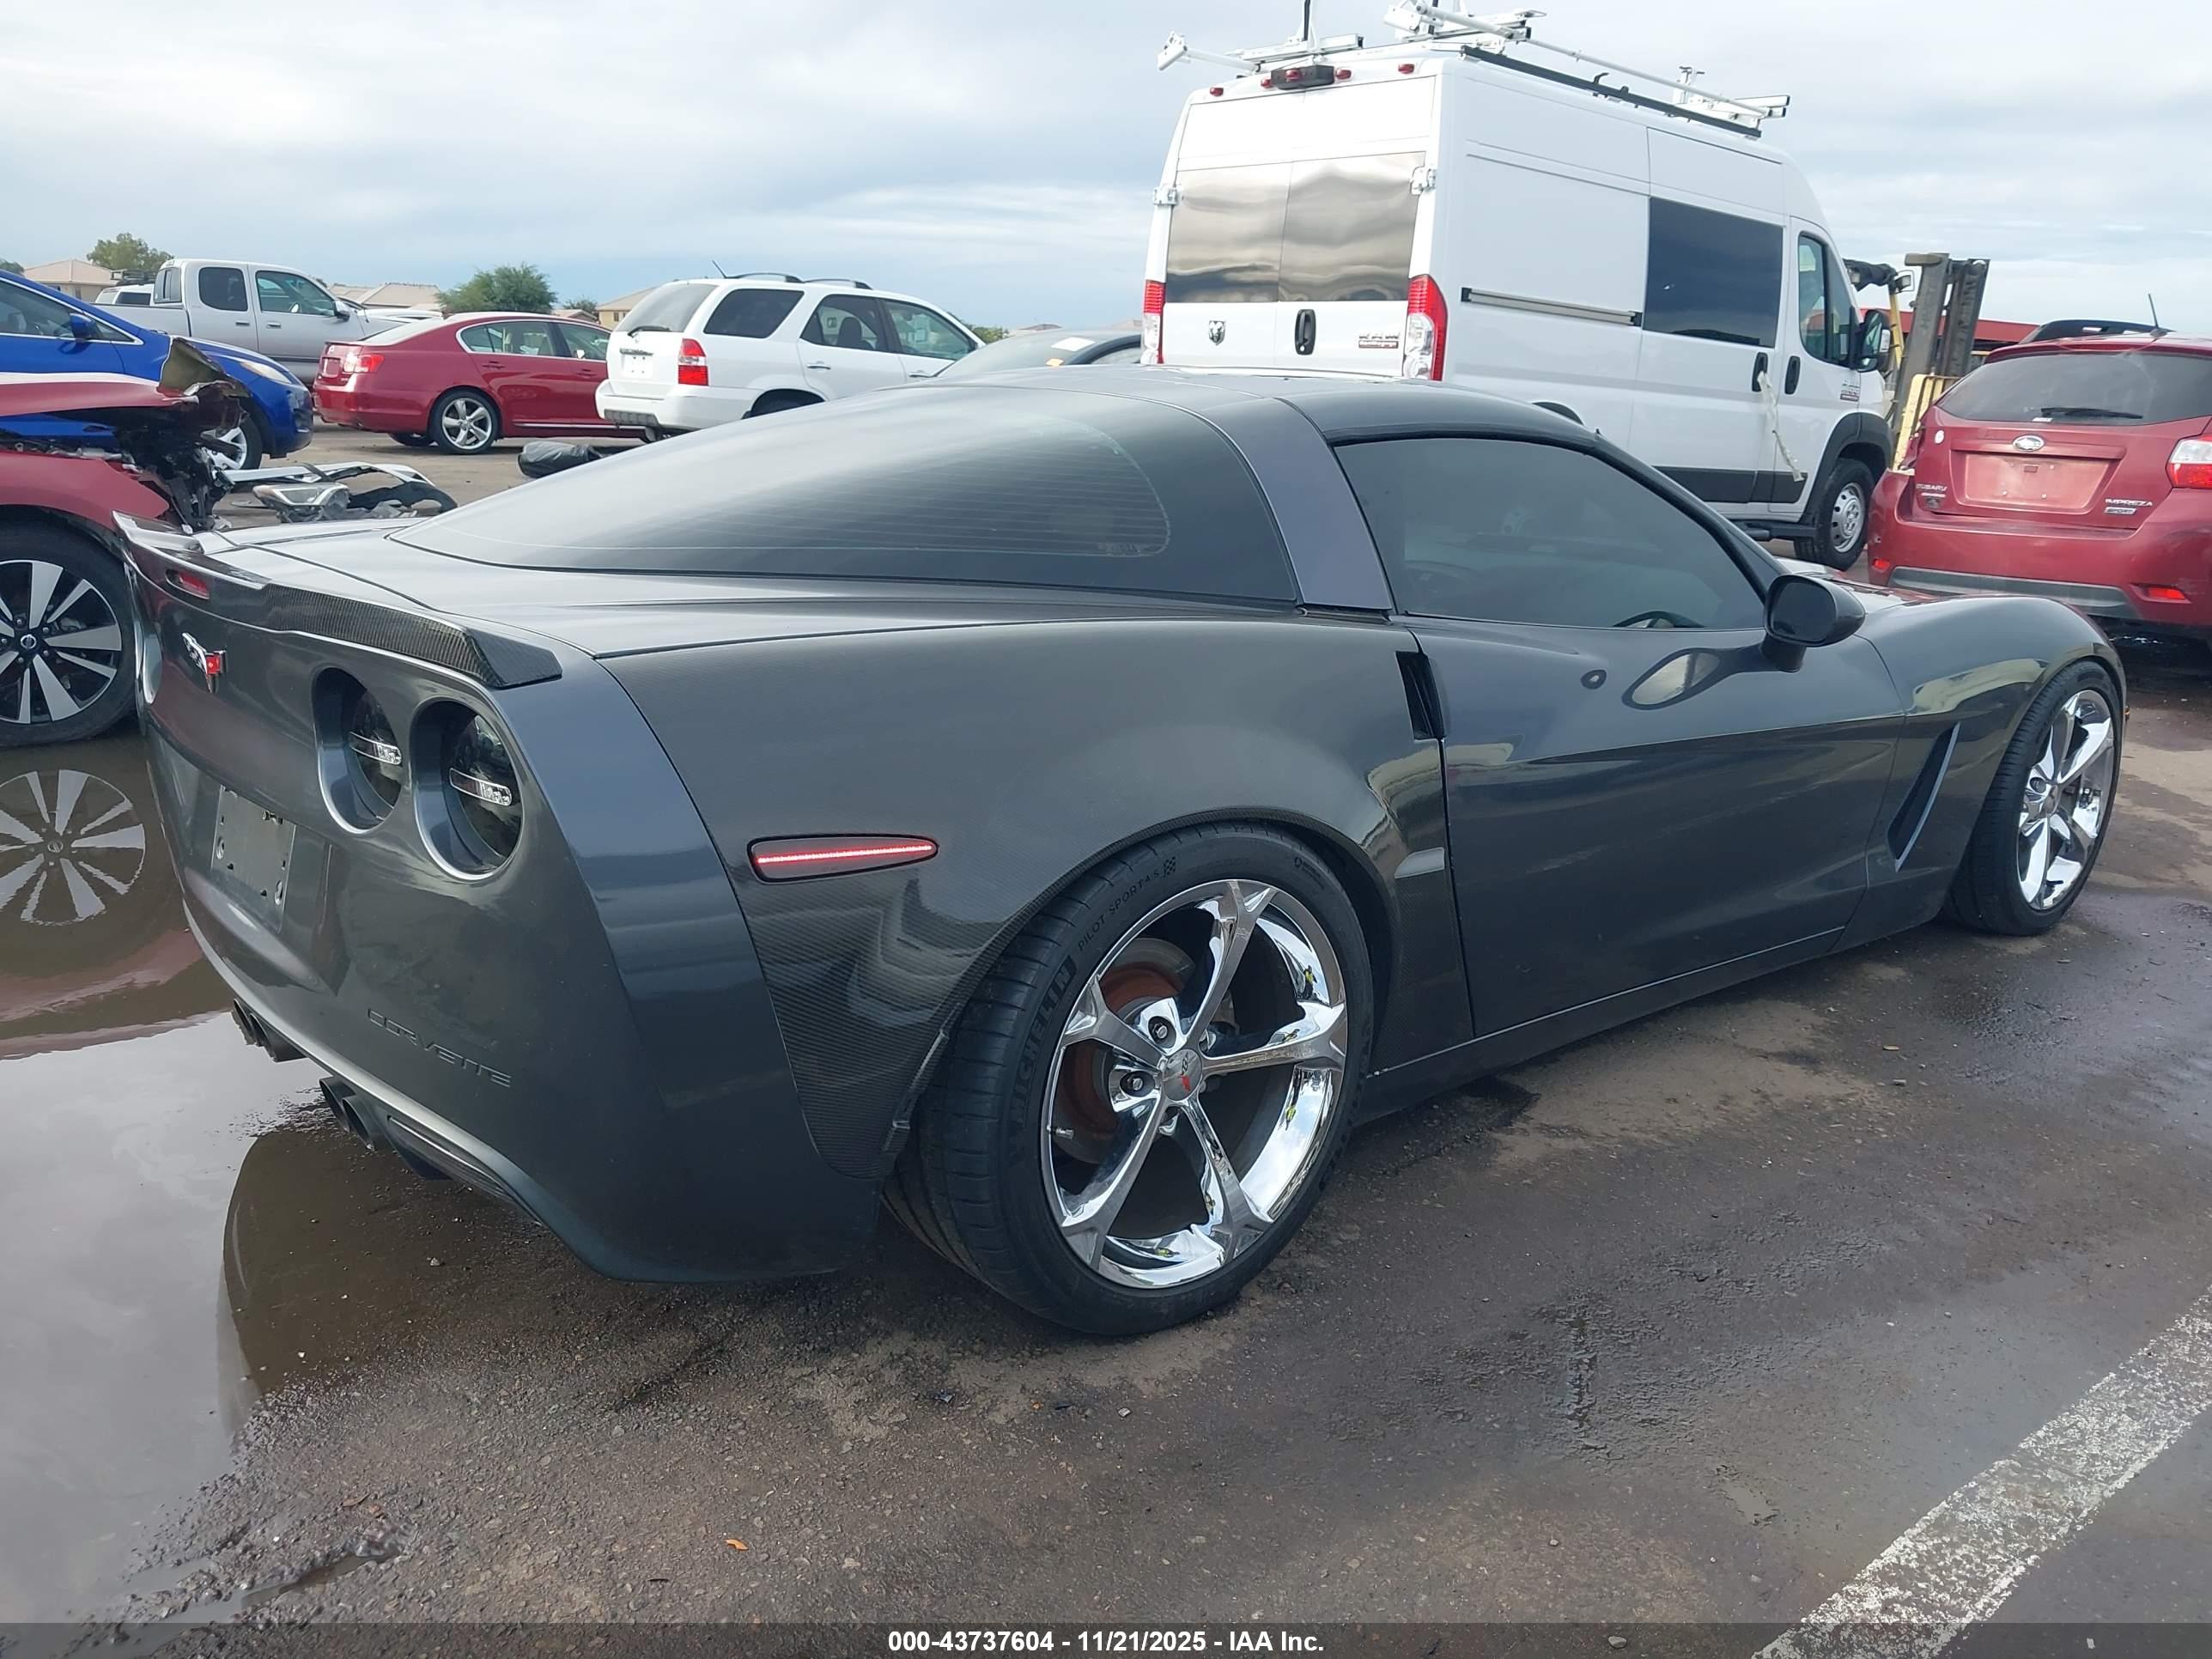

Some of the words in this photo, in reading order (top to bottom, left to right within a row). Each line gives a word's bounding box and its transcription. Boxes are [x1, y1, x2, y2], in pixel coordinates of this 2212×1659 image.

[2105, 498, 2153, 507] IMPREZA
[1079, 915, 1105, 951] PILOT
[1109, 879, 1144, 914] SPORT
[368, 1008, 512, 1088] CORVETTE
[1008, 954, 1078, 1133] MICHELIN
